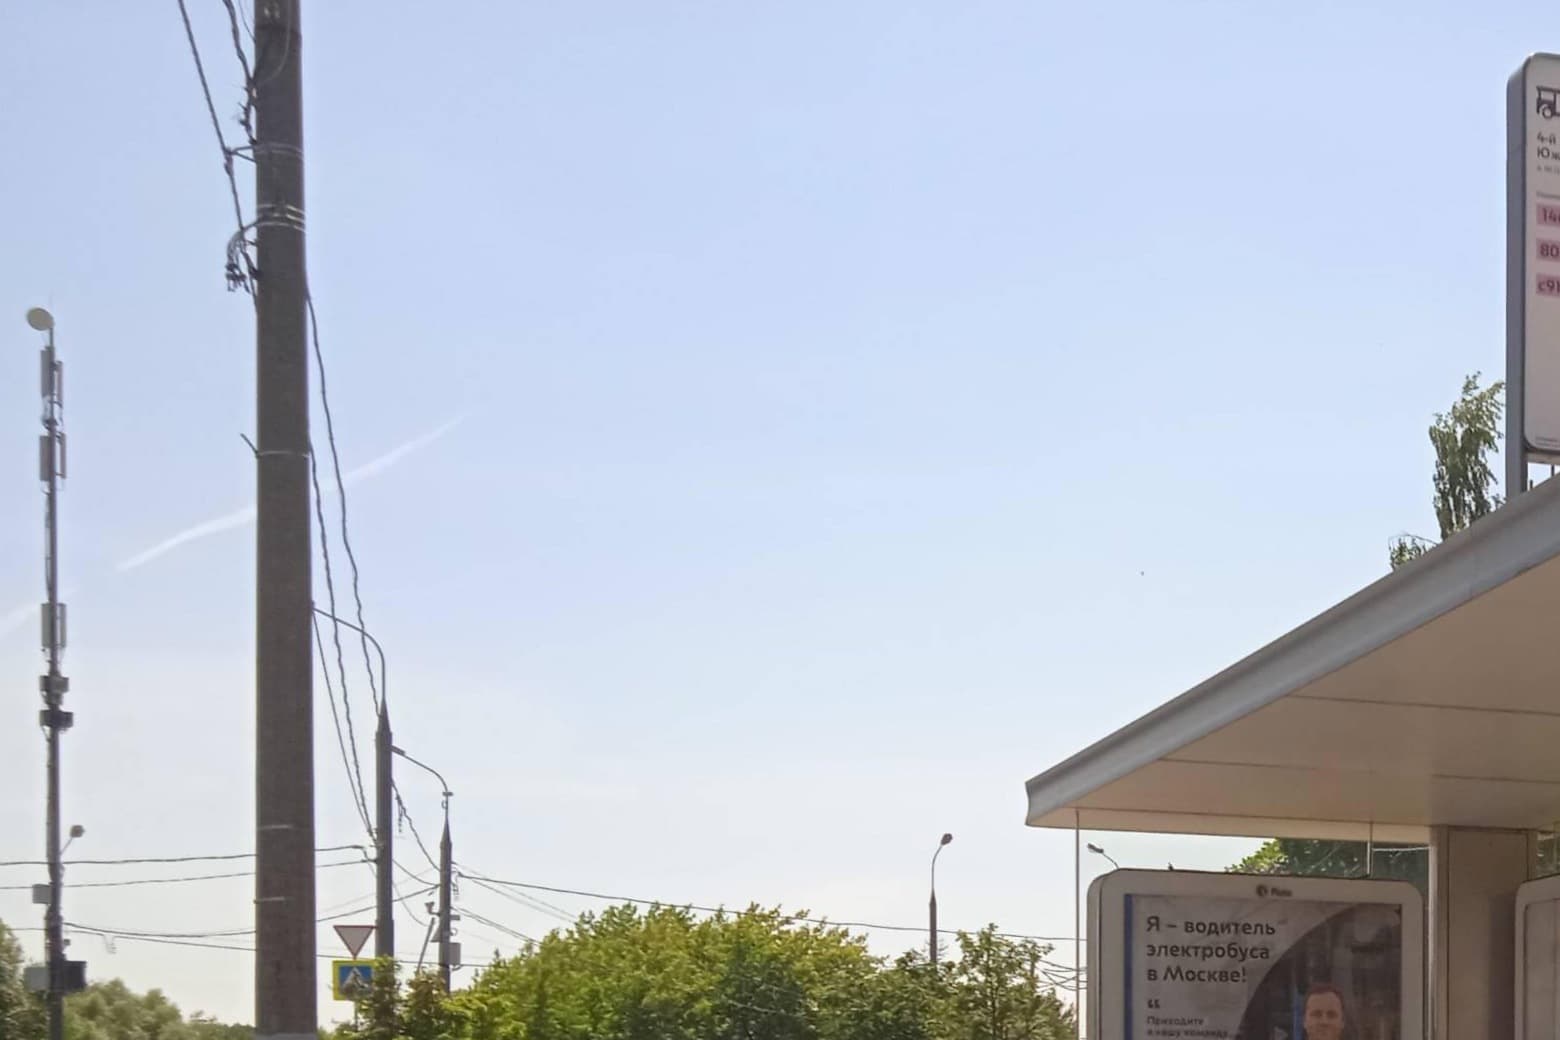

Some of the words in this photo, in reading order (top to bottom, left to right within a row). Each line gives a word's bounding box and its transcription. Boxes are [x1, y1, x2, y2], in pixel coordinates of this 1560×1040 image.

[1537, 131, 1556, 145] 4-й
[1146, 916, 1160, 932] Я
[1184, 920, 1276, 935] водитель
[1146, 943, 1270, 962] электробуса
[1147, 968, 1158, 982] в
[1163, 967, 1248, 983] Москве!
